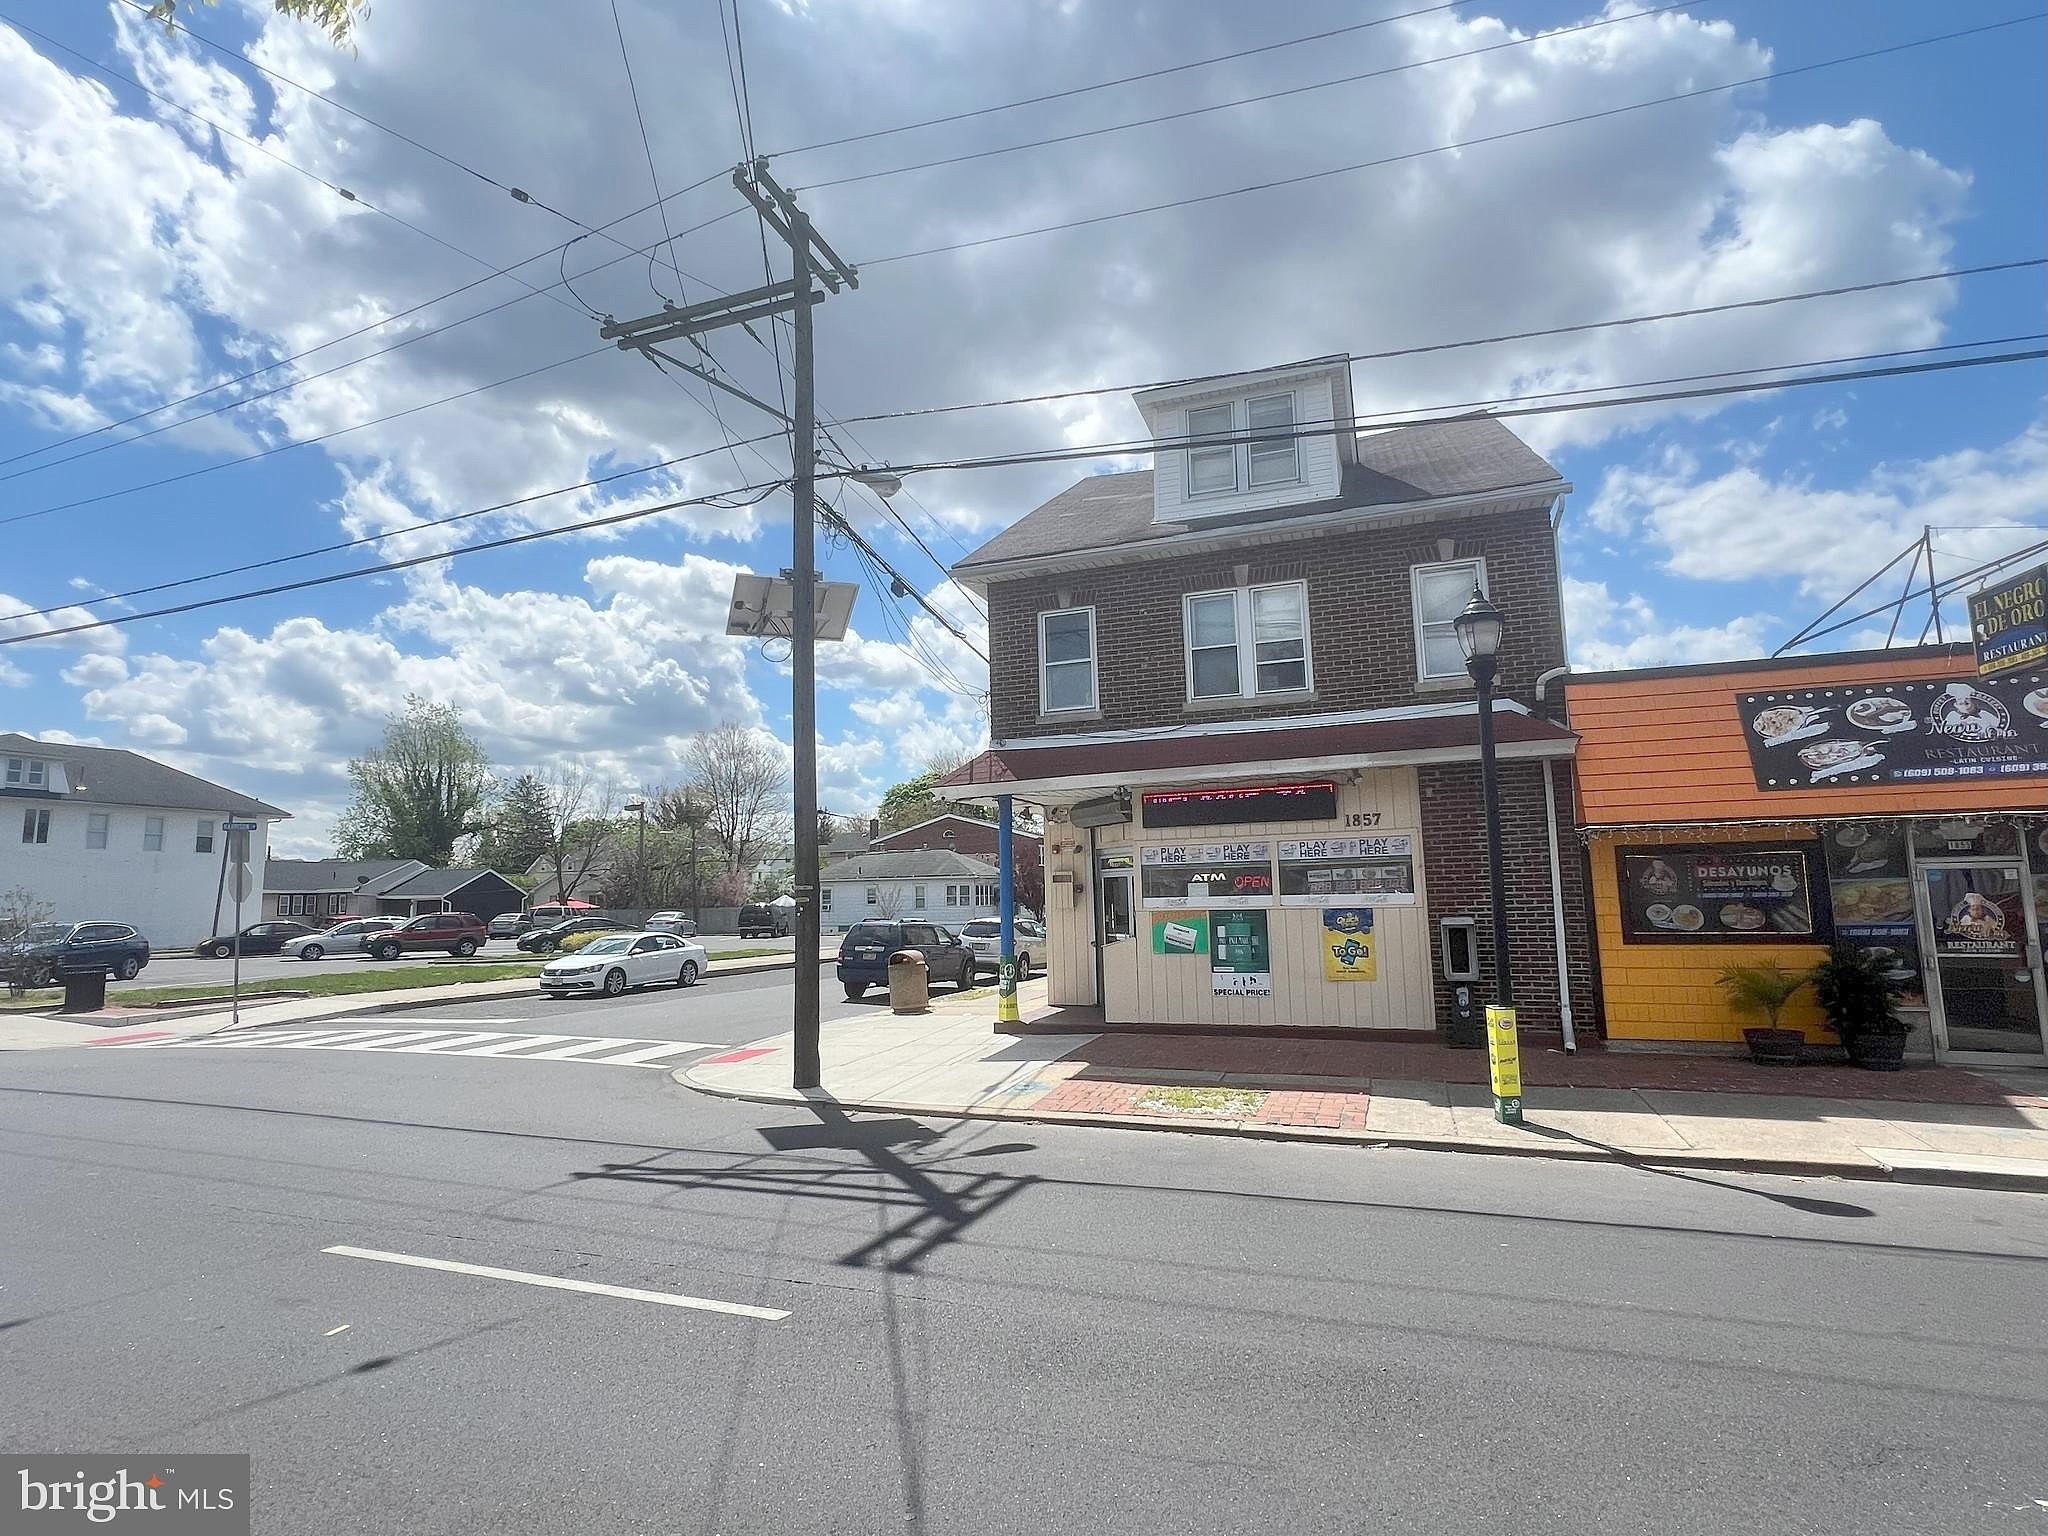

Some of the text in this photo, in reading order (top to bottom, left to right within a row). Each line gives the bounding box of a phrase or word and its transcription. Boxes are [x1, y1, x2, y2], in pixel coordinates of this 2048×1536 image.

[1974, 578, 2046, 620] EL NEGRO
[1987, 600, 2045, 635] DE ORO
[1983, 632, 2048, 661] RESTAURANT
[1924, 743, 2040, 760] RESTAURANT
[2000, 762, 2048, 773] (609) 39
[1345, 813, 1382, 827] 1857
[1300, 841, 1327, 849] PLAY
[1360, 838, 1388, 847] PLAY
[1160, 847, 1186, 855] PLAY
[1223, 844, 1250, 852] PLAY
[1360, 846, 1389, 855] HERE
[1223, 852, 1250, 860] HERE
[1300, 849, 1327, 858] HERE
[1161, 855, 1186, 863] HERE
[1697, 865, 1792, 878] DESAYUNOS
[1191, 873, 1227, 882] ATM
[1234, 875, 1270, 889] OPEN
